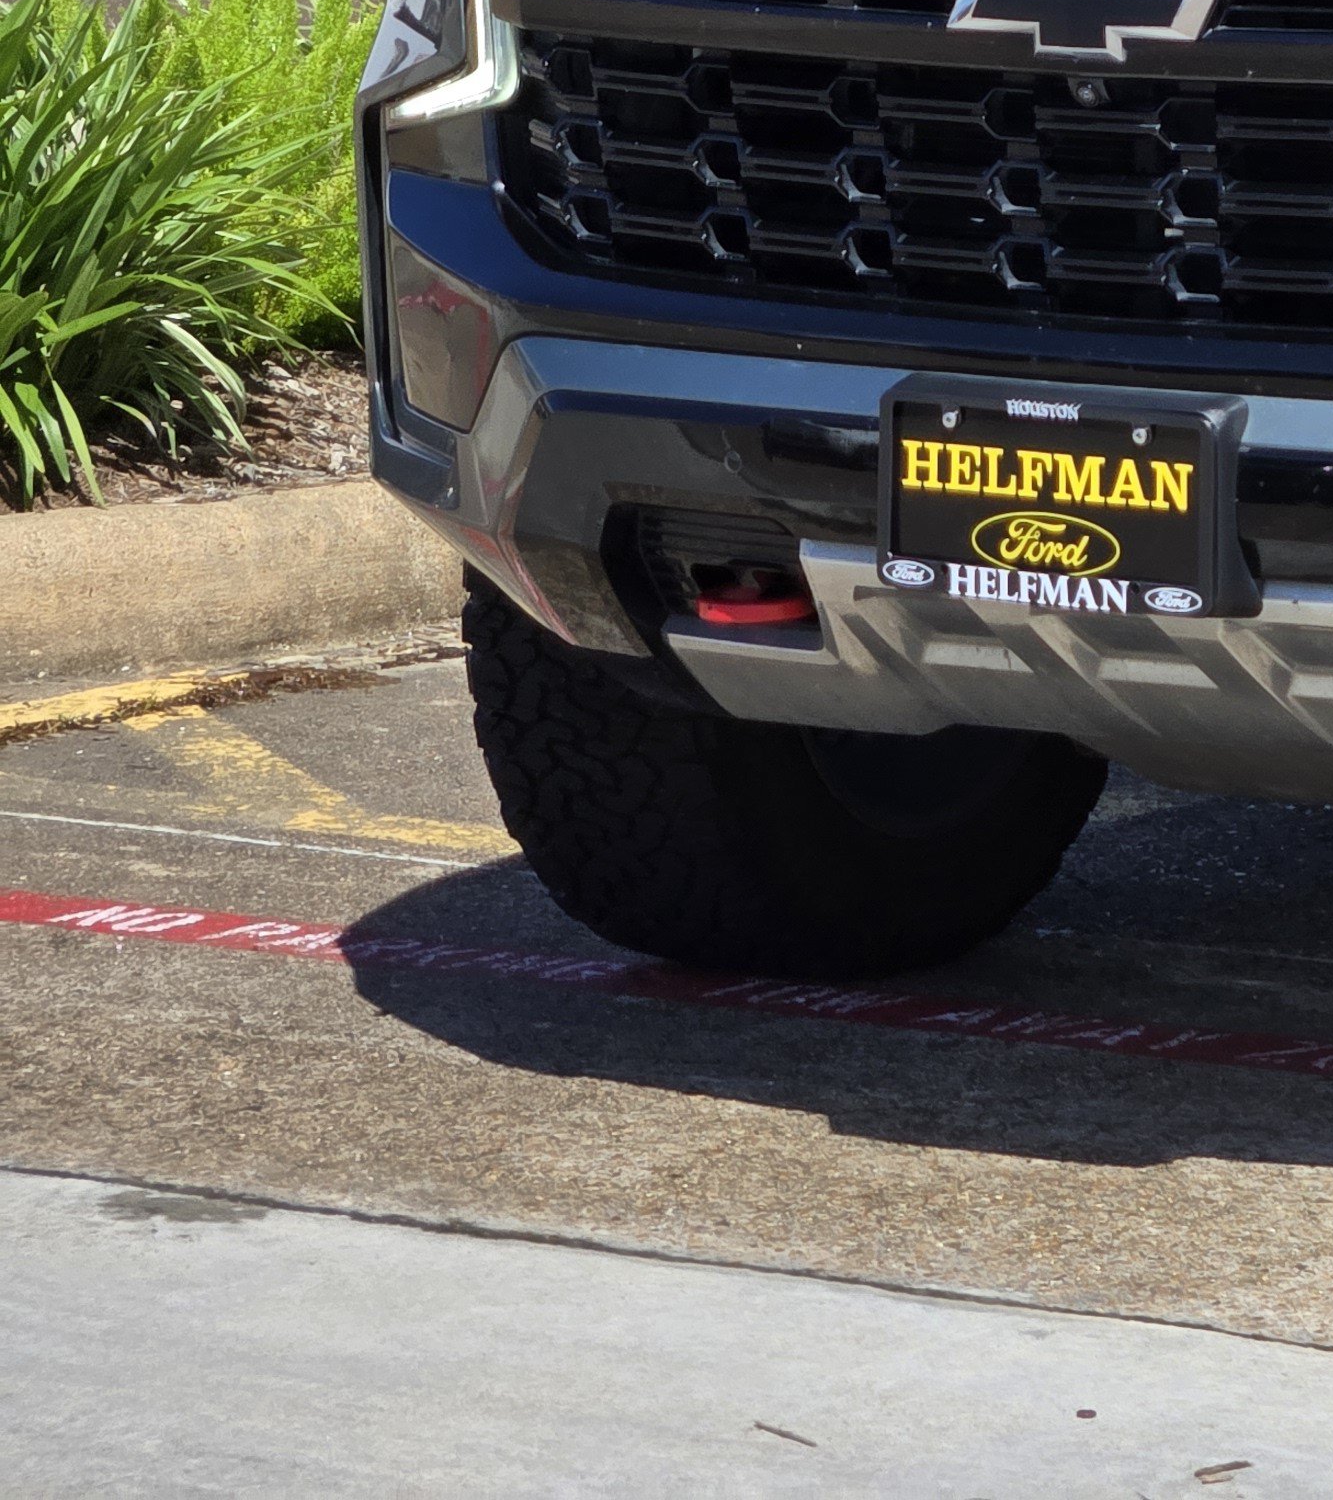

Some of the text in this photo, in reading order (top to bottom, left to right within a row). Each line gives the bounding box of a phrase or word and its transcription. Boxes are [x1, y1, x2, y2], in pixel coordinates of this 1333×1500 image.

[1005, 398, 1083, 422] HOUSTON
[901, 439, 1194, 513] HELFMAN
[999, 517, 1089, 568] Ford
[948, 562, 1131, 615] HELFMAN
[46, 904, 205, 933] NO
